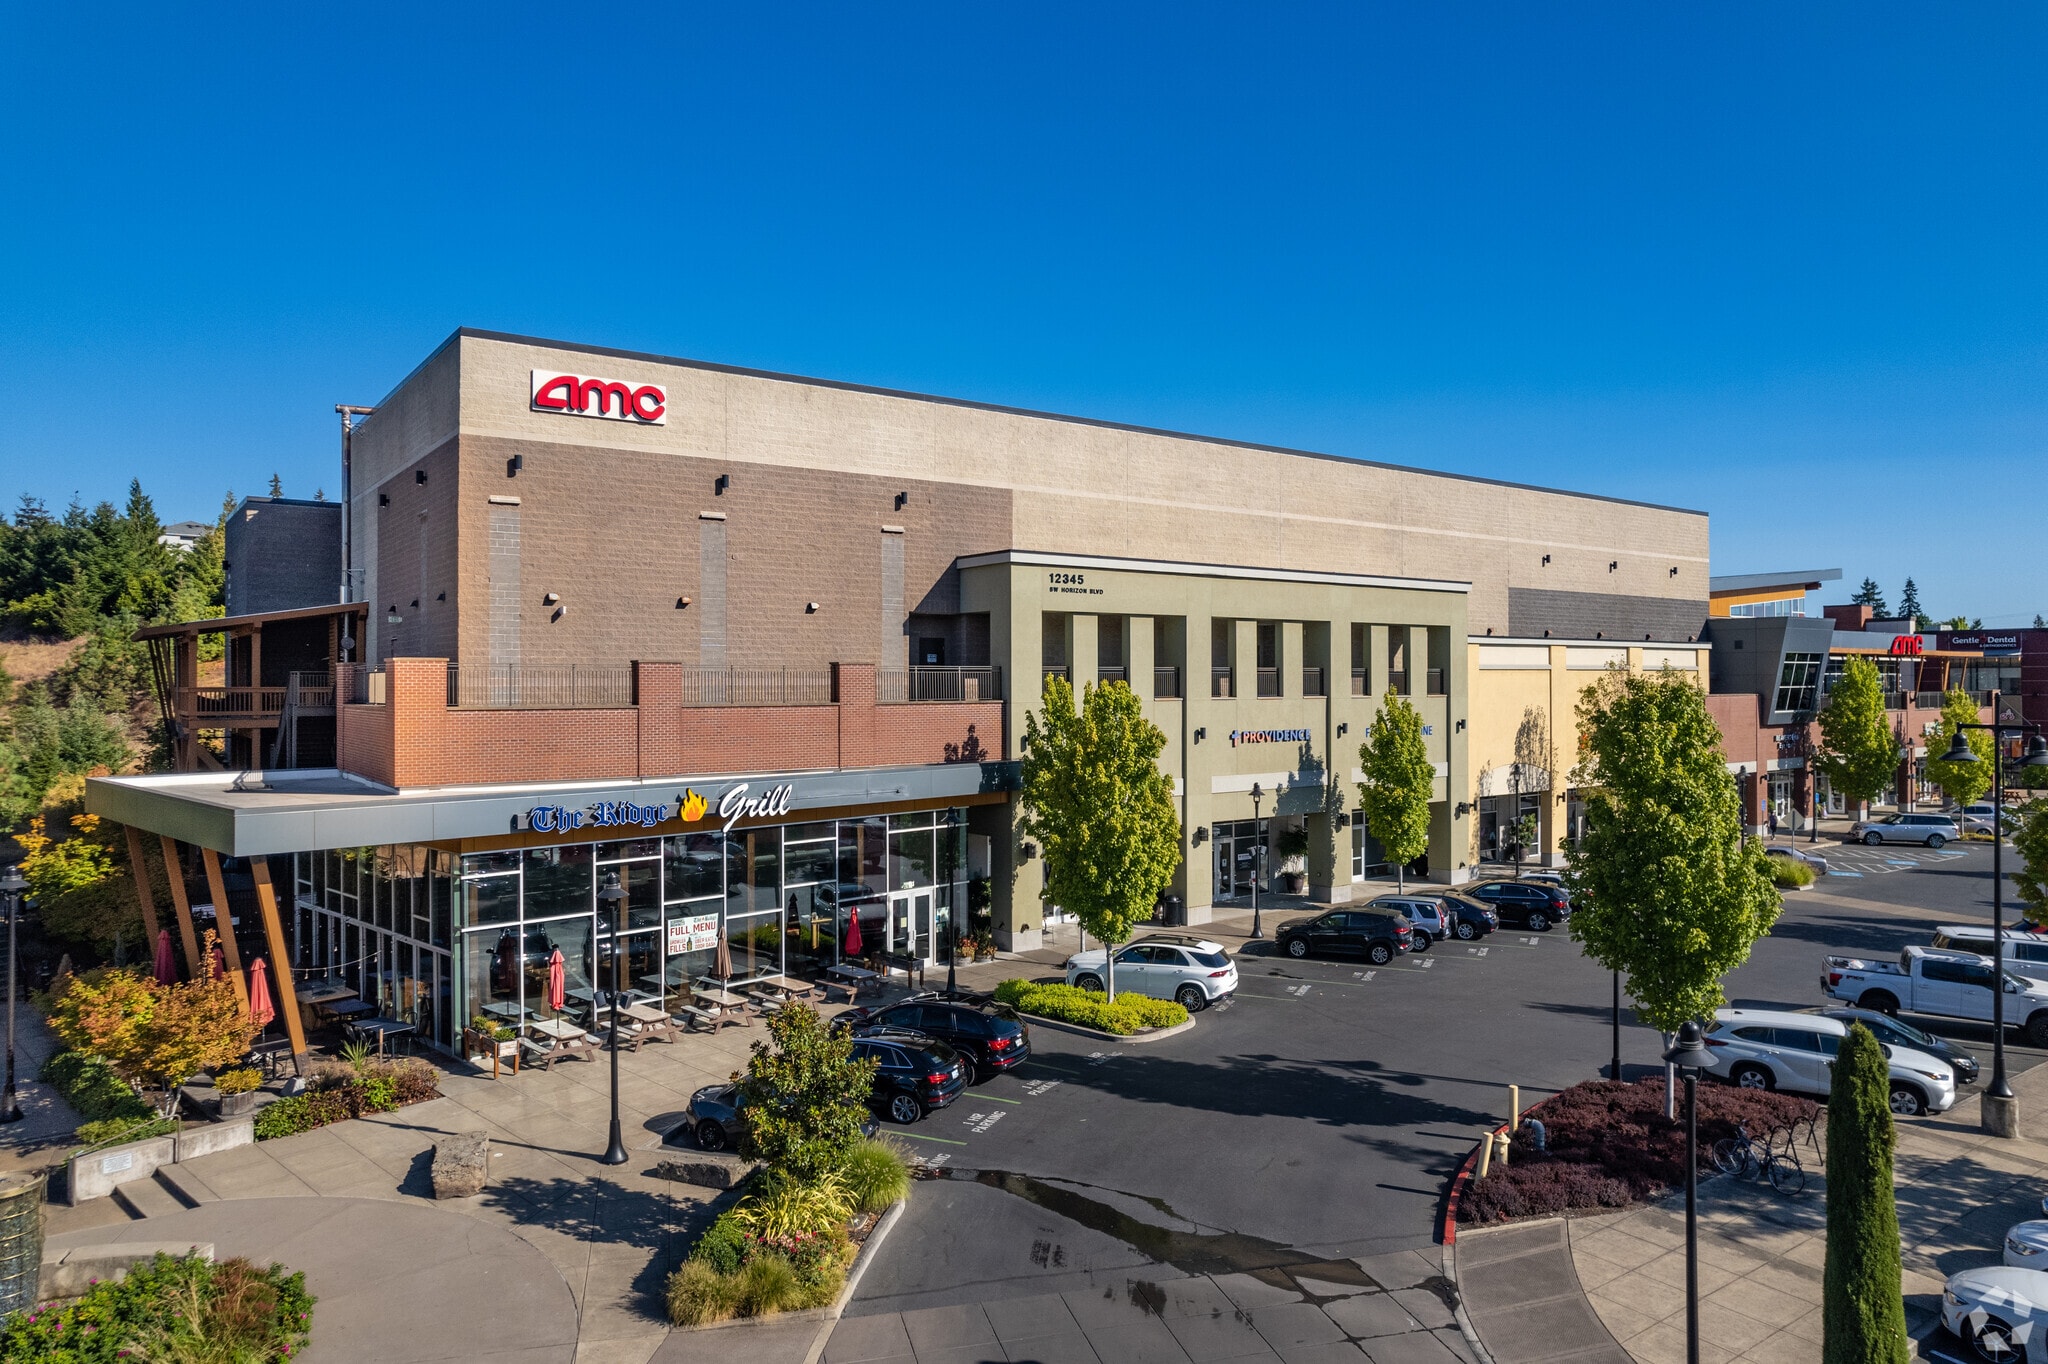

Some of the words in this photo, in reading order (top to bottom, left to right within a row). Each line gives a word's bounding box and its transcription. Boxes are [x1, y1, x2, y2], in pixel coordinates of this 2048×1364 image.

[1048, 572, 1085, 585] 12345
[1952, 636, 1980, 644] Gentle
[1987, 635, 2017, 644] Dental
[1242, 728, 1312, 743] PROVIDENCE
[531, 805, 585, 835] The
[593, 799, 670, 828] Ridge
[718, 783, 794, 833] Grill
[670, 926, 690, 936] FULL
[693, 921, 716, 932] MENU
[670, 944, 686, 954] FILLS
[966, 1112, 986, 1122] HR
[970, 1110, 1008, 1134] PARKING
